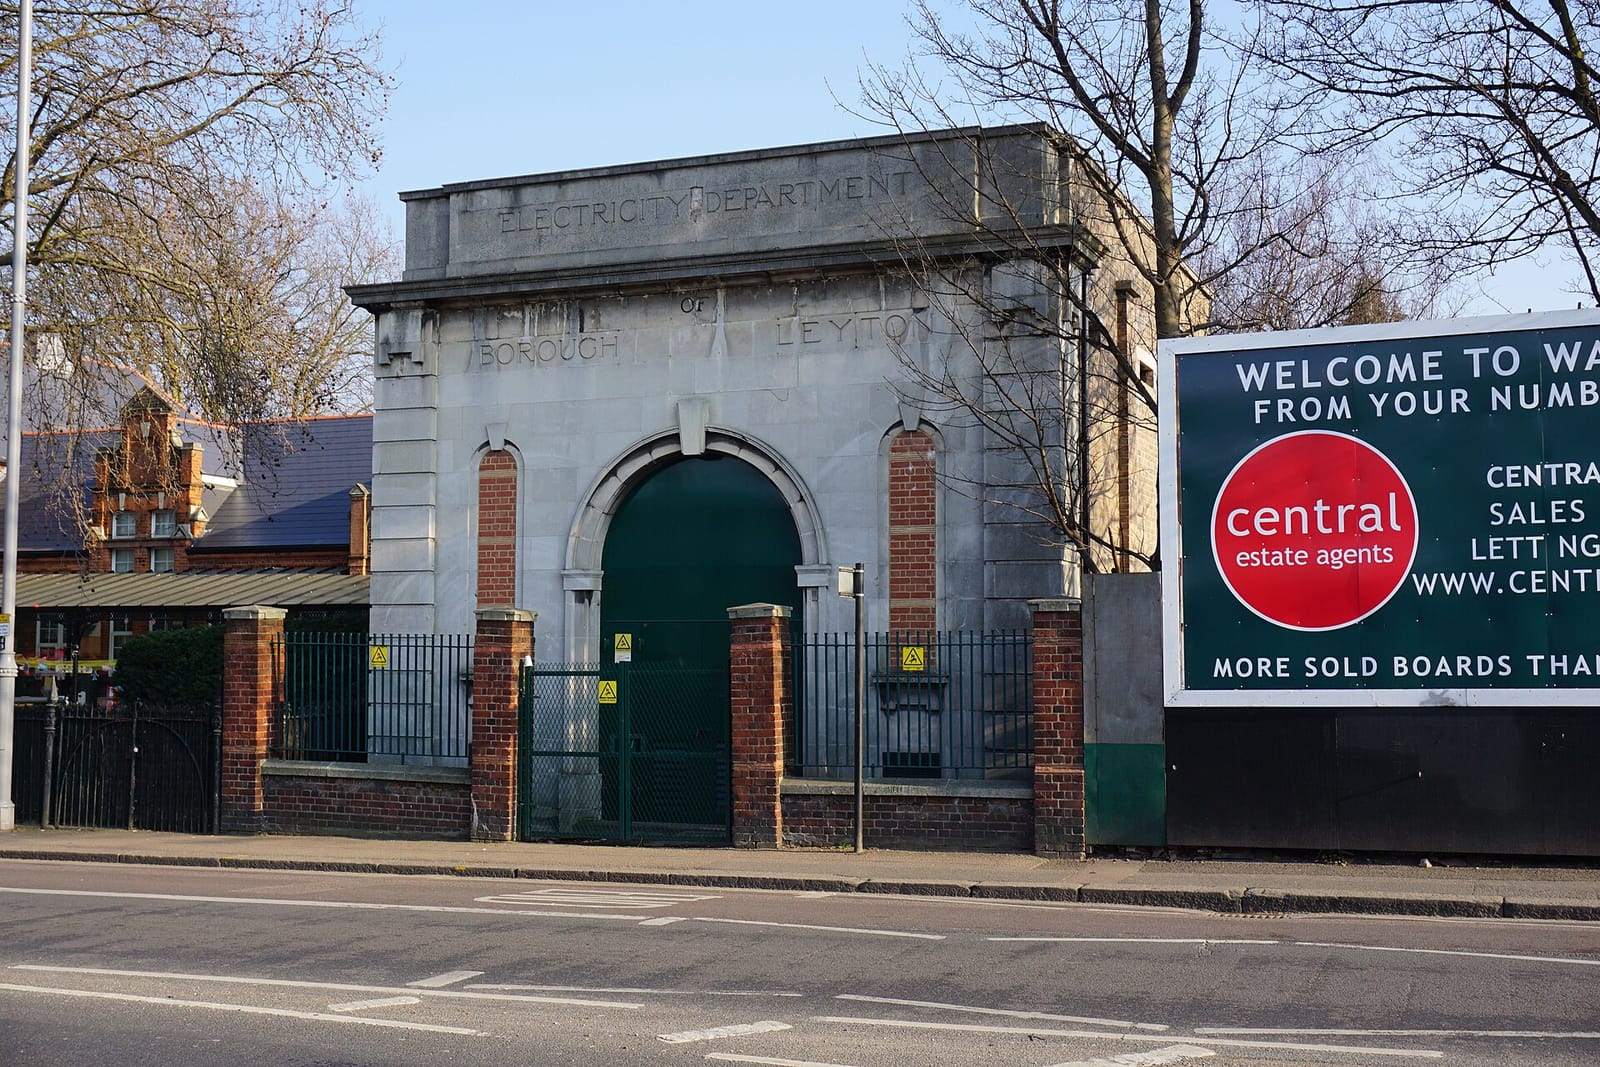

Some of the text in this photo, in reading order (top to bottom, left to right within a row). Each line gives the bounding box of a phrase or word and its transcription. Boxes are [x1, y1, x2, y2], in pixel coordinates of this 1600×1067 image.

[499, 171, 912, 233] ELECTRICITY DEPARTMENT
[480, 297, 933, 366] BOROUGH OF LEYTON
[1235, 351, 1443, 392] WELCOME
[1463, 345, 1520, 378] TO
[1254, 381, 1600, 424] FROM YOUR NUMB
[1487, 462, 1600, 488] CENTRA
[1227, 492, 1402, 537] central
[1490, 499, 1585, 526] SALES
[1236, 544, 1394, 570] estate agents
[1213, 654, 1600, 678] MORE SOLD BOARDS THA
